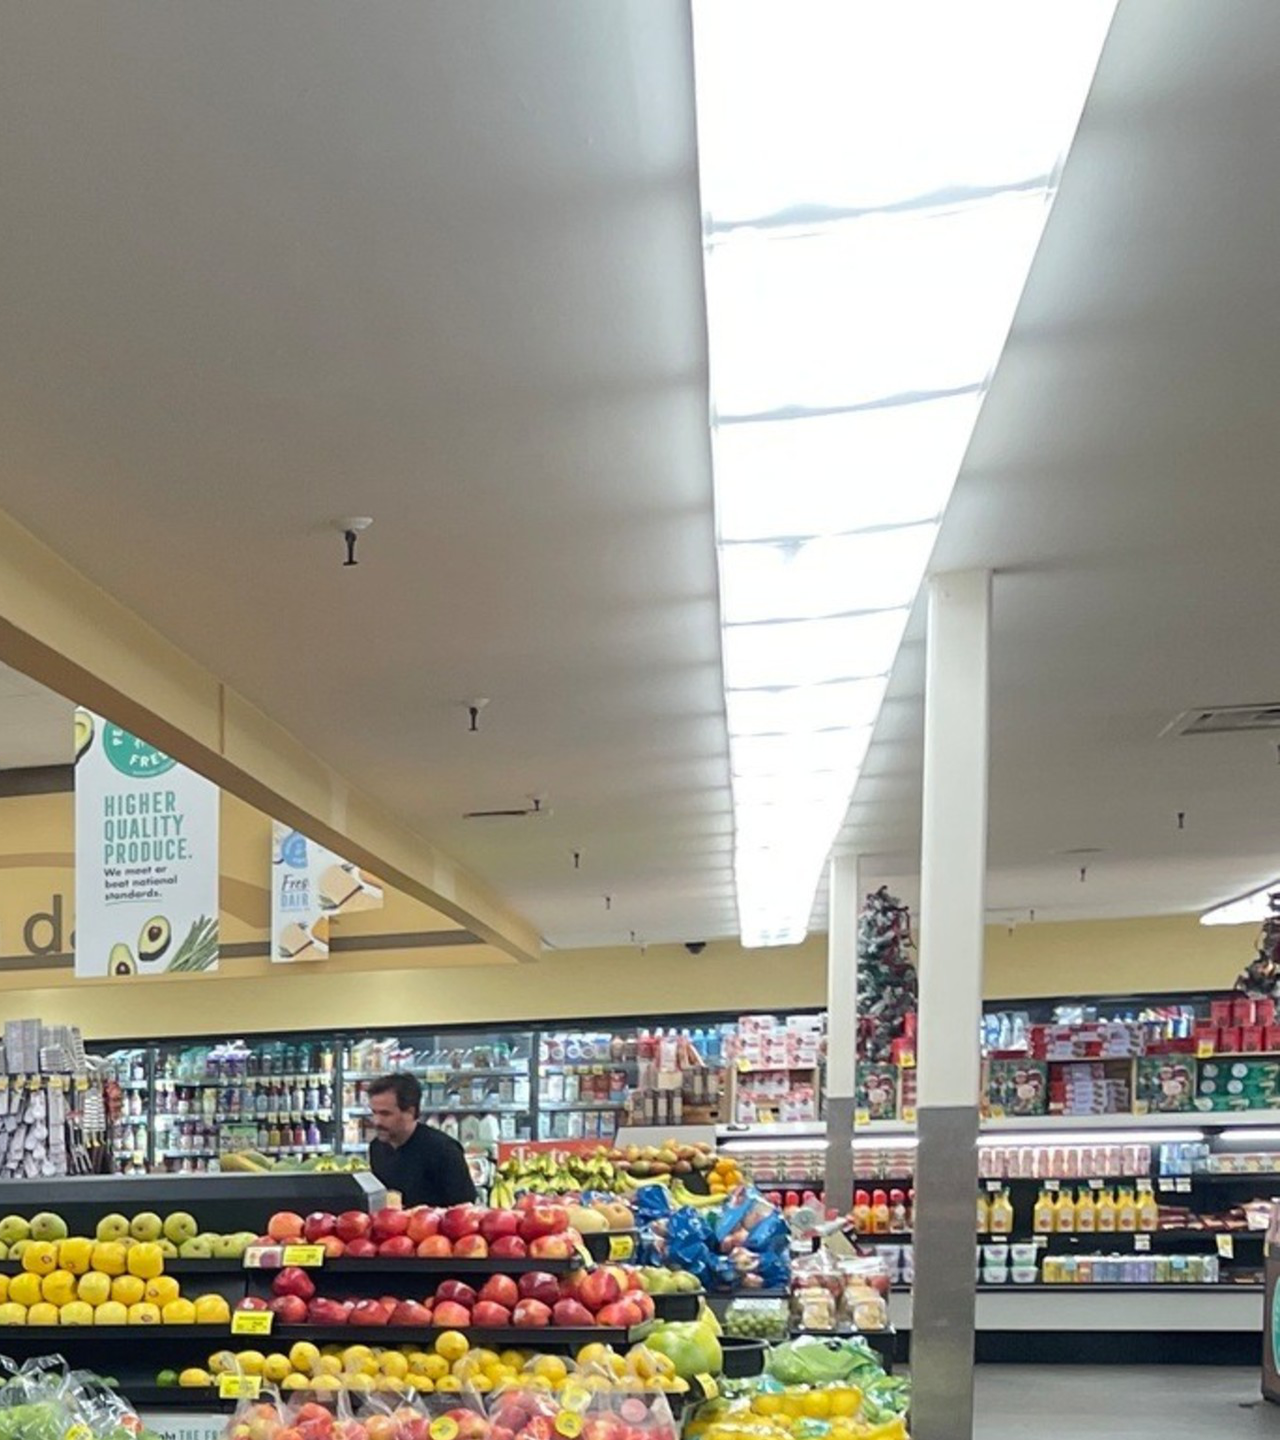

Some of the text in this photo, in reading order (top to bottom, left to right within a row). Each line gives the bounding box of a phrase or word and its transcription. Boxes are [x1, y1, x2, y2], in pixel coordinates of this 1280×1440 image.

[104, 791, 176, 817] HIGHER
[104, 814, 184, 841] QUALITY
[104, 839, 193, 865] PRODUCE.
[104, 867, 122, 878] We
[155, 865, 167, 874] or
[105, 875, 178, 888] beat national
[105, 889, 162, 901] standards.
